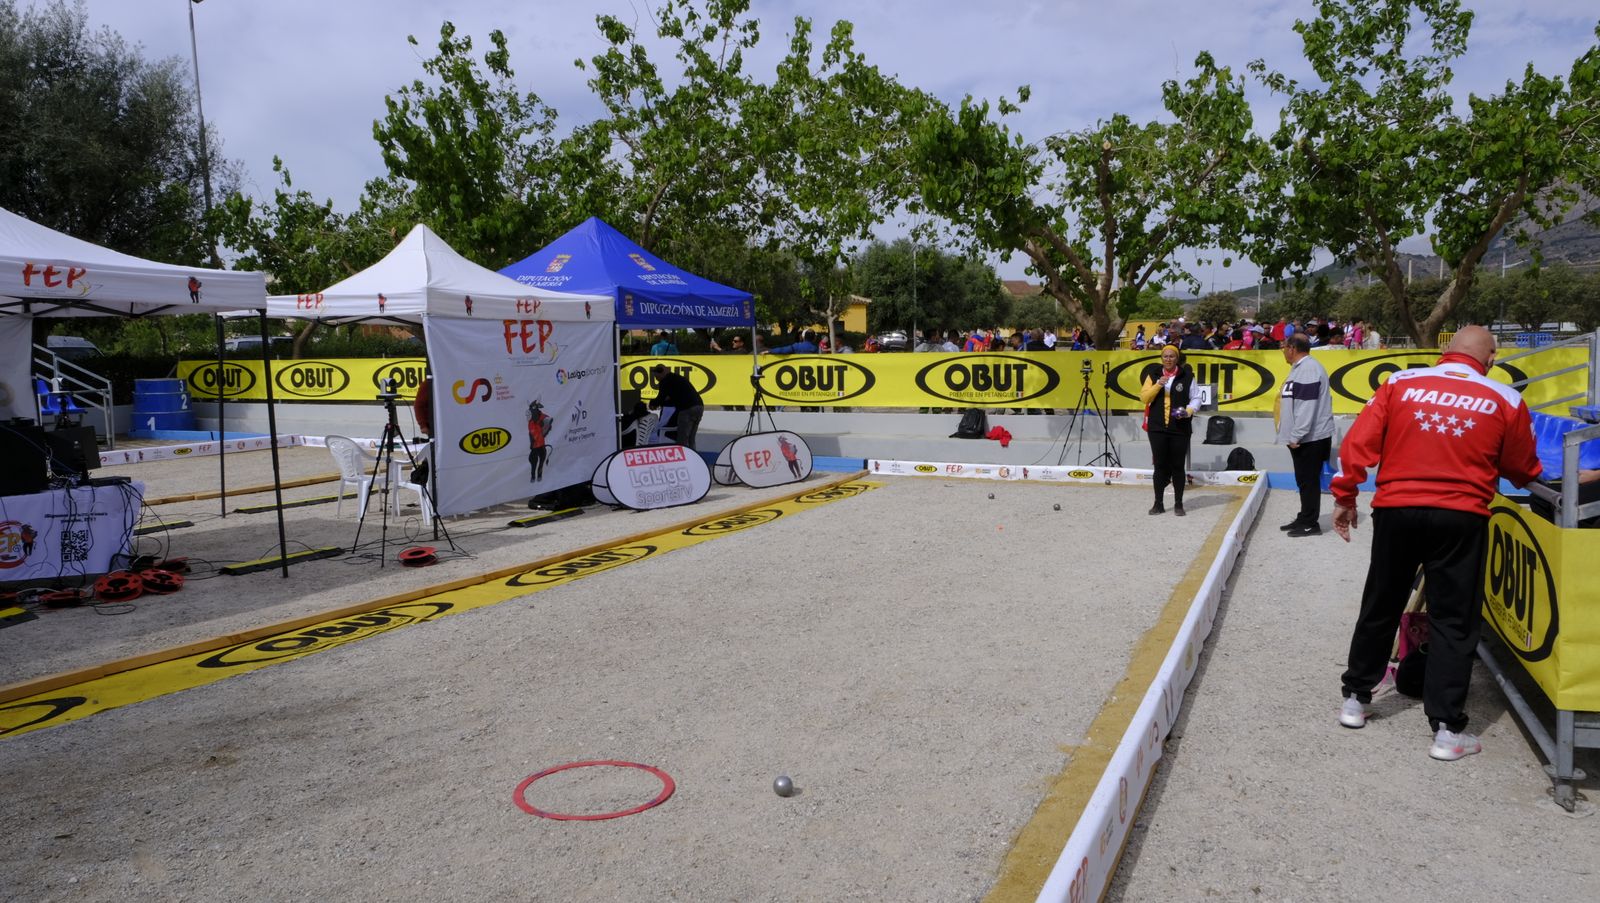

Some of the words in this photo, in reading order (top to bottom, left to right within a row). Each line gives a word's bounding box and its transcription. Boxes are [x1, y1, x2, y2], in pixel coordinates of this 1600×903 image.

[22, 263, 87, 288] FEP
[296, 293, 324, 309] FEP
[640, 302, 695, 316] DIPUTACIÓN
[696, 304, 706, 317] DE
[707, 304, 739, 317] ALMERÍA
[503, 318, 554, 354] FEP
[180, 380, 185, 392] 3
[290, 367, 334, 389] OBUT
[775, 364, 848, 391] OBUT
[944, 363, 1028, 392] OBUT
[181, 394, 187, 409] 2
[1401, 388, 1498, 415] MADRID
[147, 416, 156, 431] 1
[470, 431, 502, 449] OBUT
[626, 448, 684, 466] PETANCA
[744, 450, 772, 470] FEP
[628, 466, 690, 489] LaLiga
[945, 464, 963, 473] FEP
[1073, 470, 1089, 478] OBUT
[1103, 470, 1122, 479] FEP
[535, 551, 634, 577] OBUT
[1490, 523, 1537, 633] OBUT
[255, 610, 413, 651] OBUT
